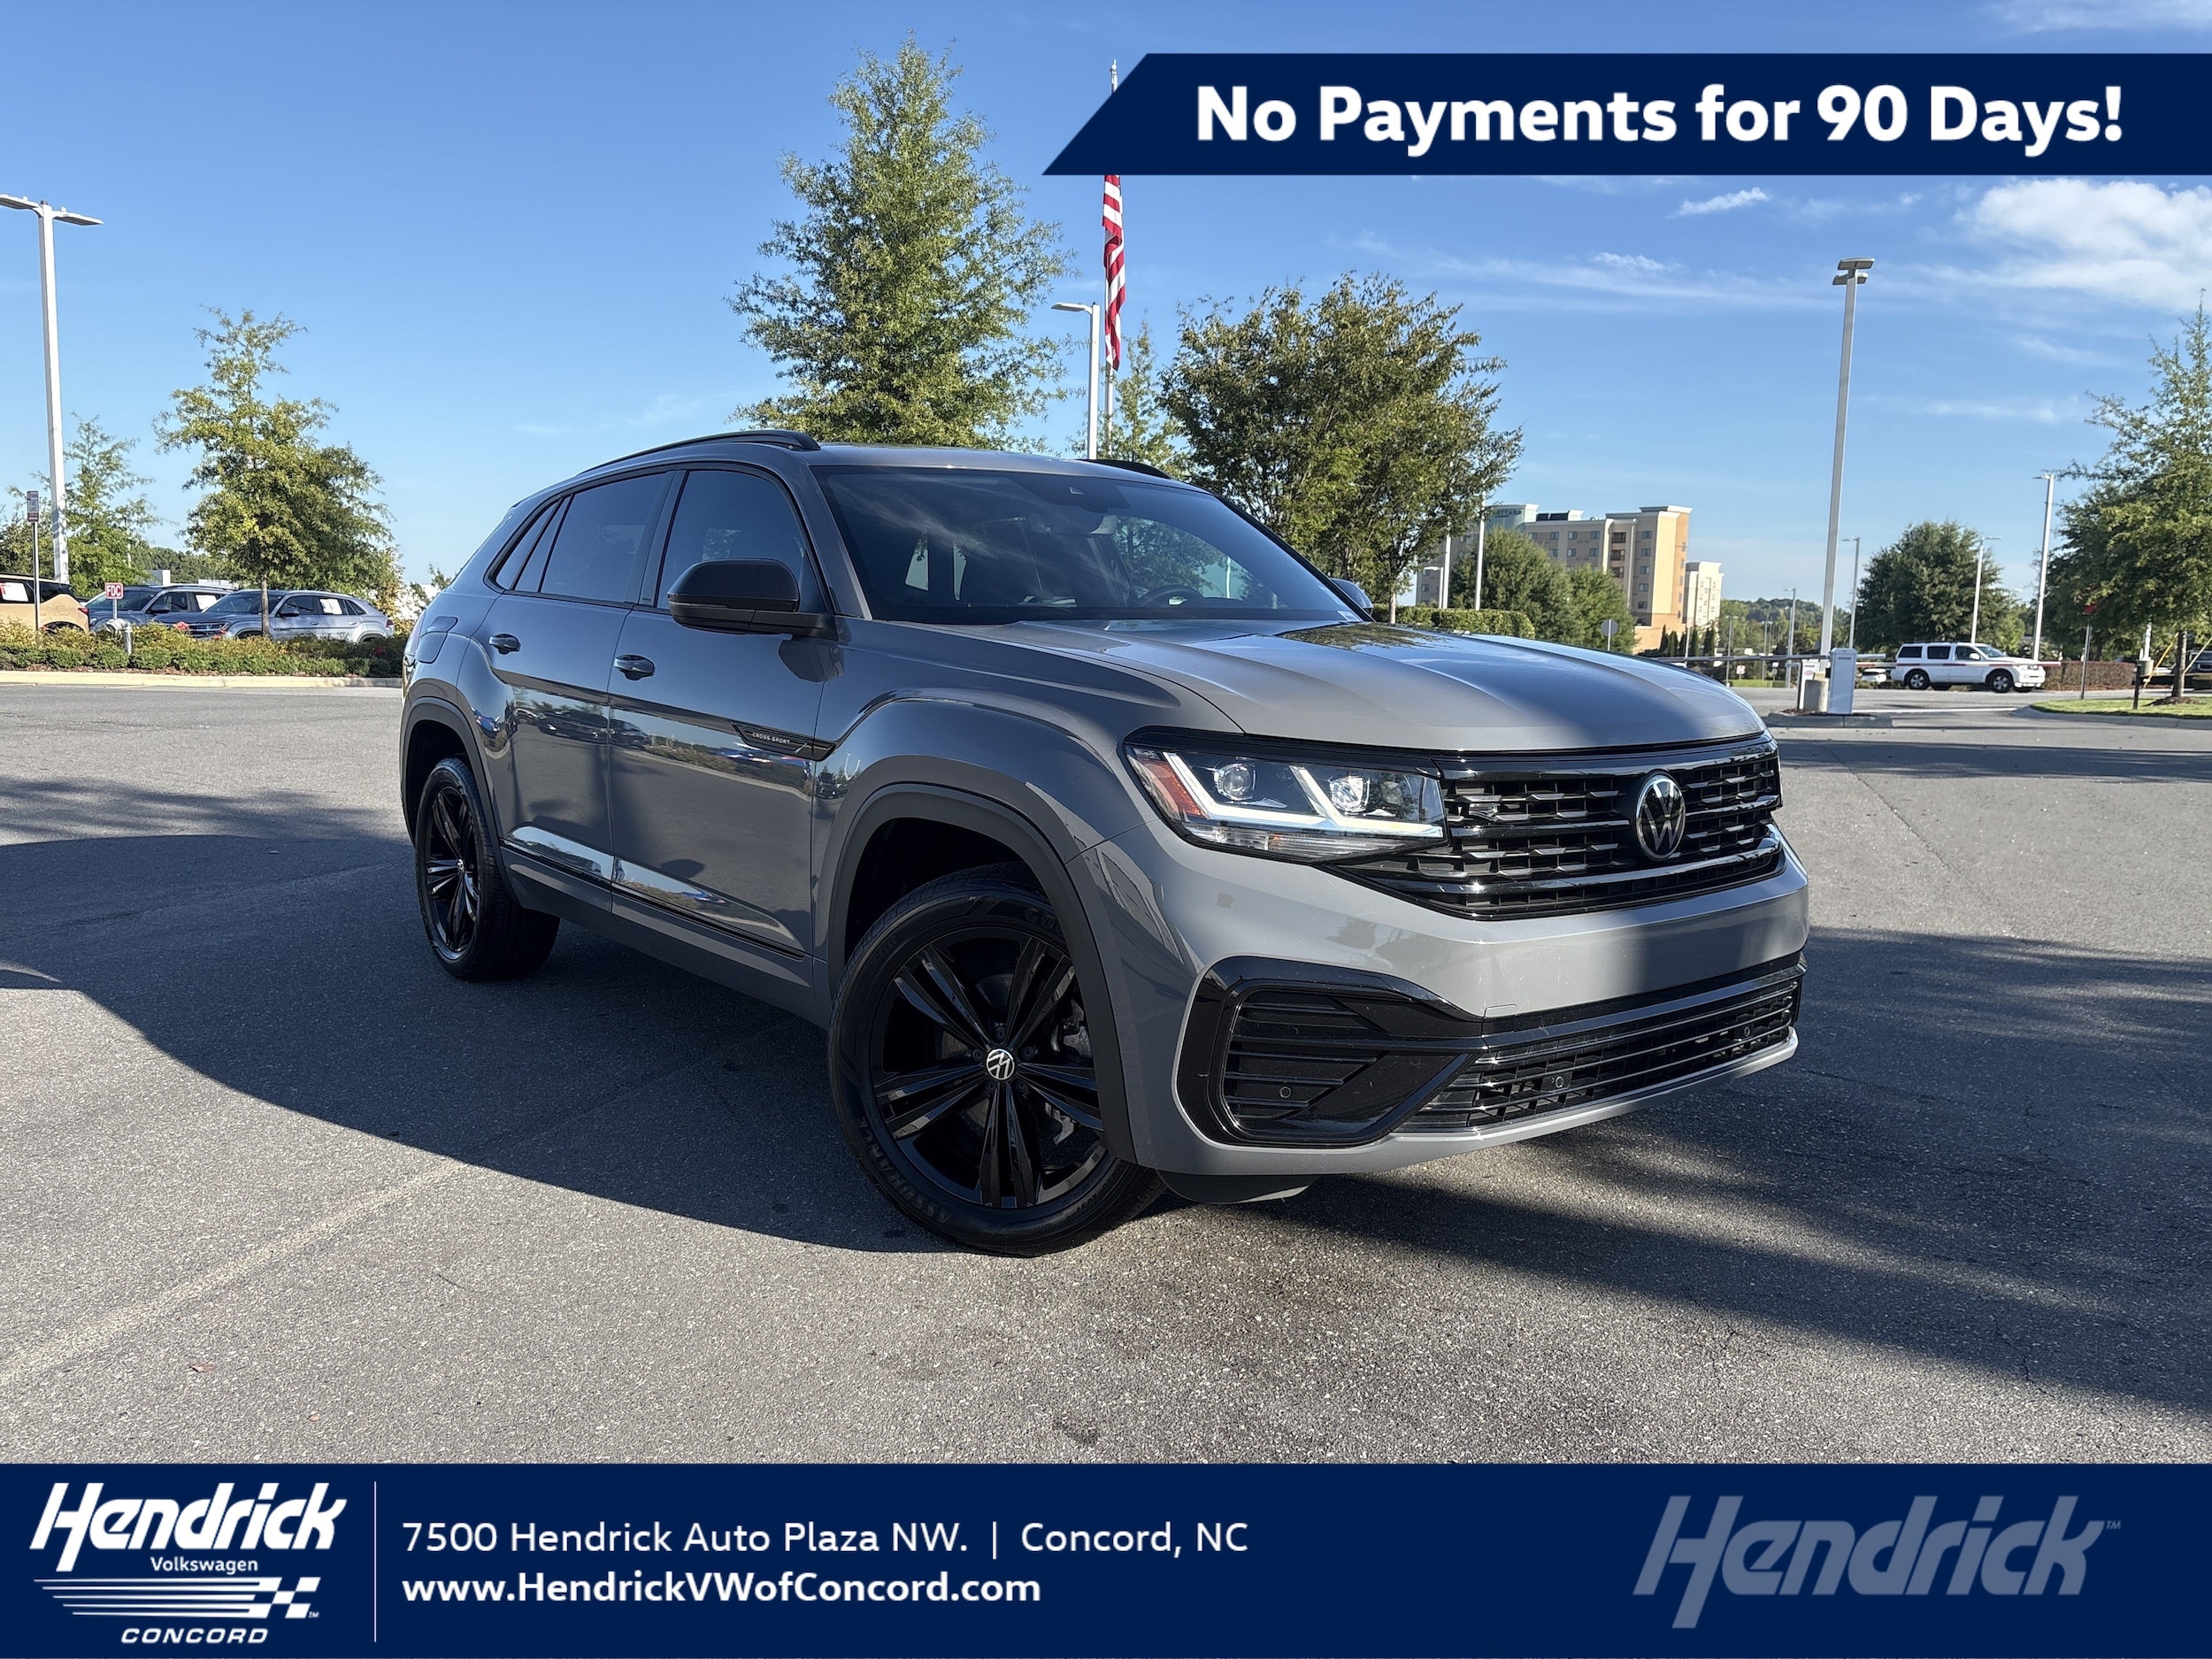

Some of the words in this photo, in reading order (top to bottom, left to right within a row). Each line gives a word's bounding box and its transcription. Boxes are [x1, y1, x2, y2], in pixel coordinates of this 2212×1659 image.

[106, 585, 121, 597] FDC
[752, 732, 771, 741] CROSS
[772, 736, 790, 745] SPORT
[856, 1118, 954, 1224] ASSURANCE
